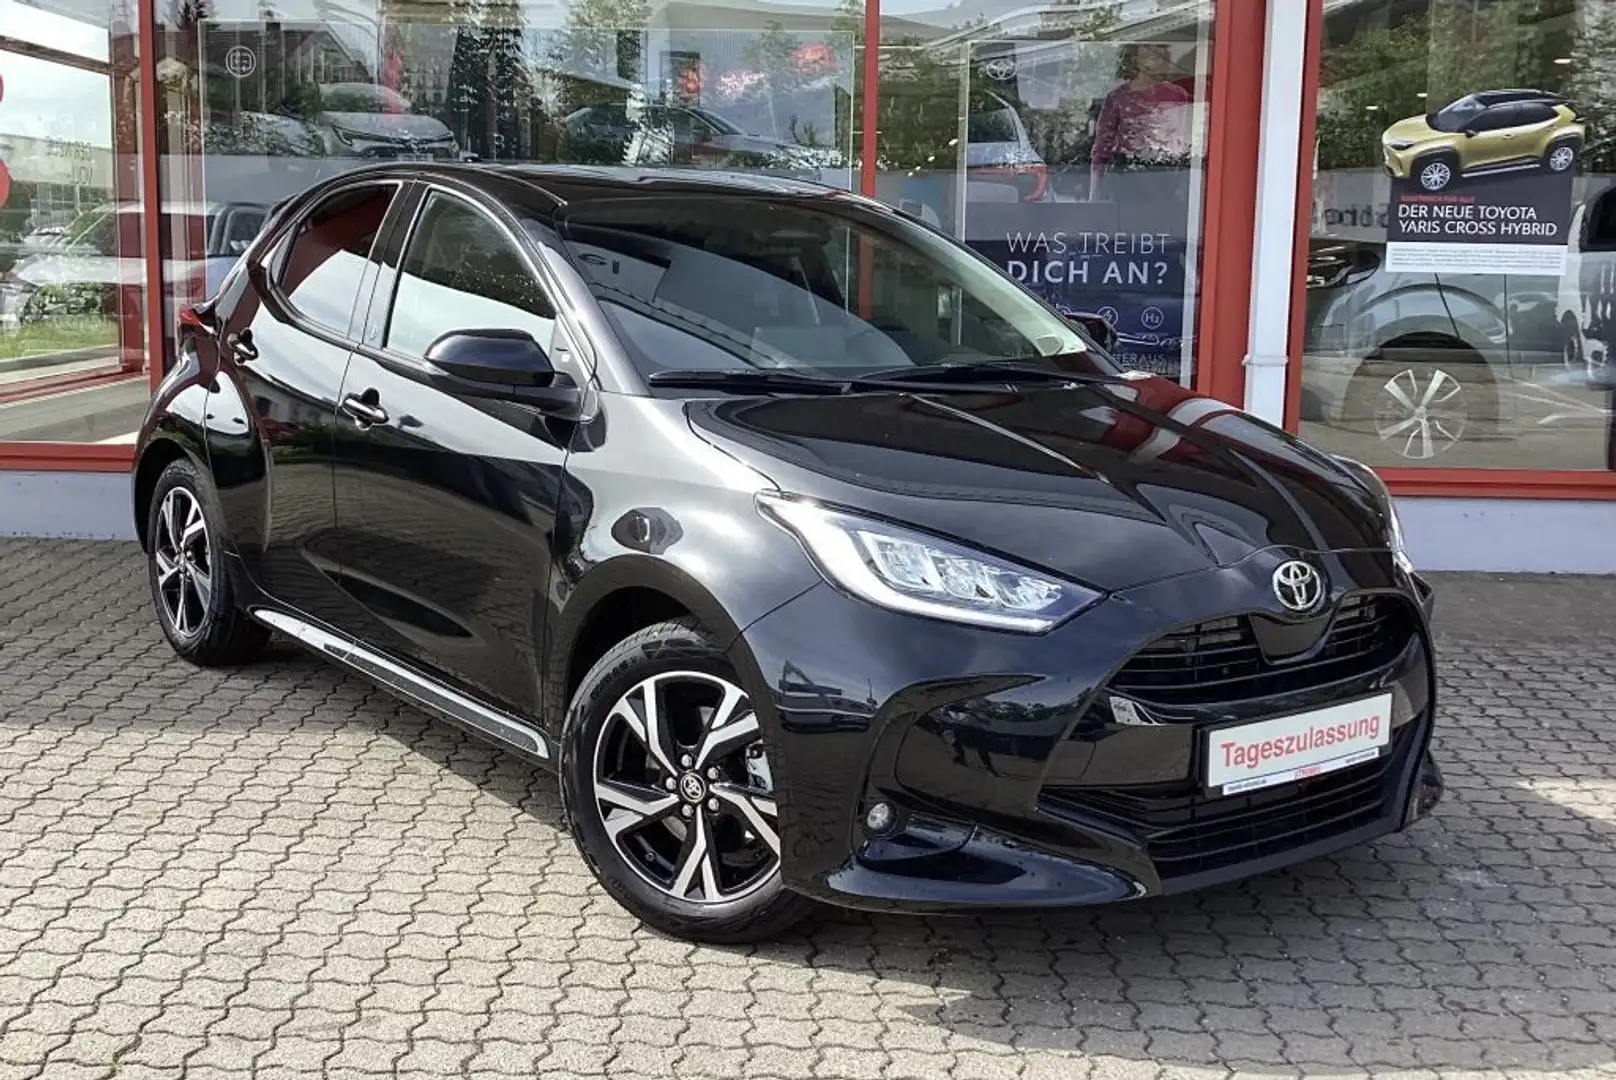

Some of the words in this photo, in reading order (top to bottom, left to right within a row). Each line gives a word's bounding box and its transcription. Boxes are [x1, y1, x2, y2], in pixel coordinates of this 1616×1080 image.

[1398, 204, 1428, 218] DER
[1432, 205, 1474, 219] NEUE
[1477, 205, 1537, 220] TOYOTA
[1398, 220, 1441, 234] YARIS
[1444, 221, 1496, 235] CROSS
[1500, 222, 1557, 236] HYBRID
[1006, 232, 1066, 254] WAS
[1078, 231, 1171, 255] TREIBT
[1006, 260, 1088, 284] DICH
[1102, 261, 1168, 284] AN?
[1221, 715, 1380, 769] Tageszulassung
